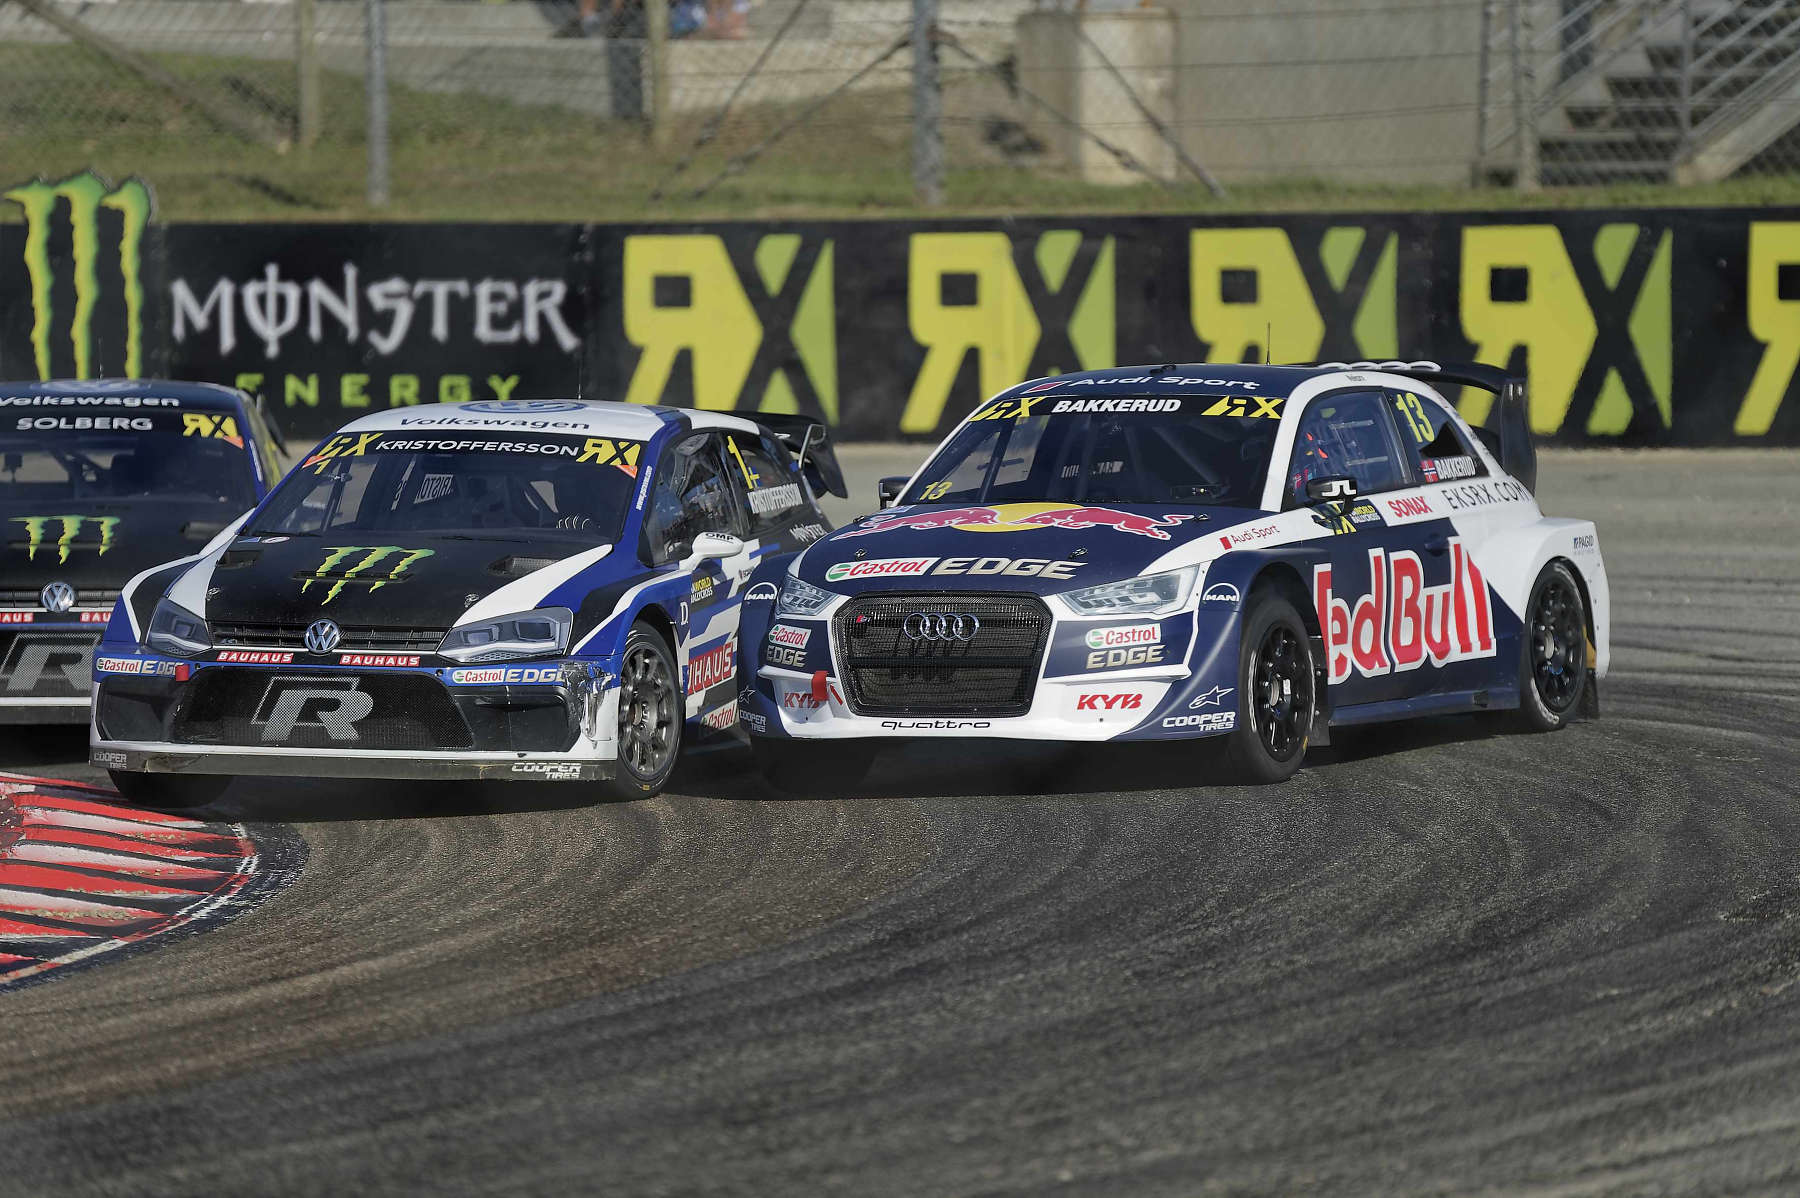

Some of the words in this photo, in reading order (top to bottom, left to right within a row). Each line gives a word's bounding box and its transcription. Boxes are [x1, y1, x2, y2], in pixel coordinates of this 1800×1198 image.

[171, 262, 581, 358] MONSTER
[1069, 377, 1154, 389] Audi
[1158, 377, 1261, 391] Sport
[1051, 398, 1182, 414] BAKKERUD
[16, 416, 154, 431] SOLBERG
[399, 416, 590, 430] Volkswagen
[1396, 391, 1436, 444] 13
[375, 439, 579, 457] KRISTOFFERSSON
[727, 435, 754, 490] 1
[918, 481, 954, 501] 13
[1441, 480, 1533, 510] EKSRX.COM
[1387, 495, 1434, 518] SONAX
[705, 532, 734, 541] OMP
[1230, 529, 1254, 545] Audi
[1251, 524, 1281, 540] Sport
[849, 561, 929, 578] Castrol
[931, 557, 1089, 580] EDGE
[1205, 594, 1237, 602] MAN
[1388, 536, 1497, 674] Bull
[775, 626, 810, 647] Castrol
[1105, 626, 1158, 645] Castrol
[217, 651, 294, 664] BAUHAUS
[340, 654, 420, 667] BAUHAUS
[765, 645, 809, 668] EDGE
[1086, 644, 1167, 670] EDGE
[103, 659, 140, 672] Castrol
[464, 669, 503, 682] Castrol
[1077, 693, 1143, 711] KYB
[706, 702, 735, 728] Castrol
[739, 709, 768, 726] COOPER
[1162, 711, 1236, 728] COOPER
[881, 720, 991, 731] quattro
[1198, 721, 1235, 732] TIRES
[93, 751, 127, 763] COOPER
[511, 762, 582, 772] COOPER
[544, 771, 580, 780] TIRES
